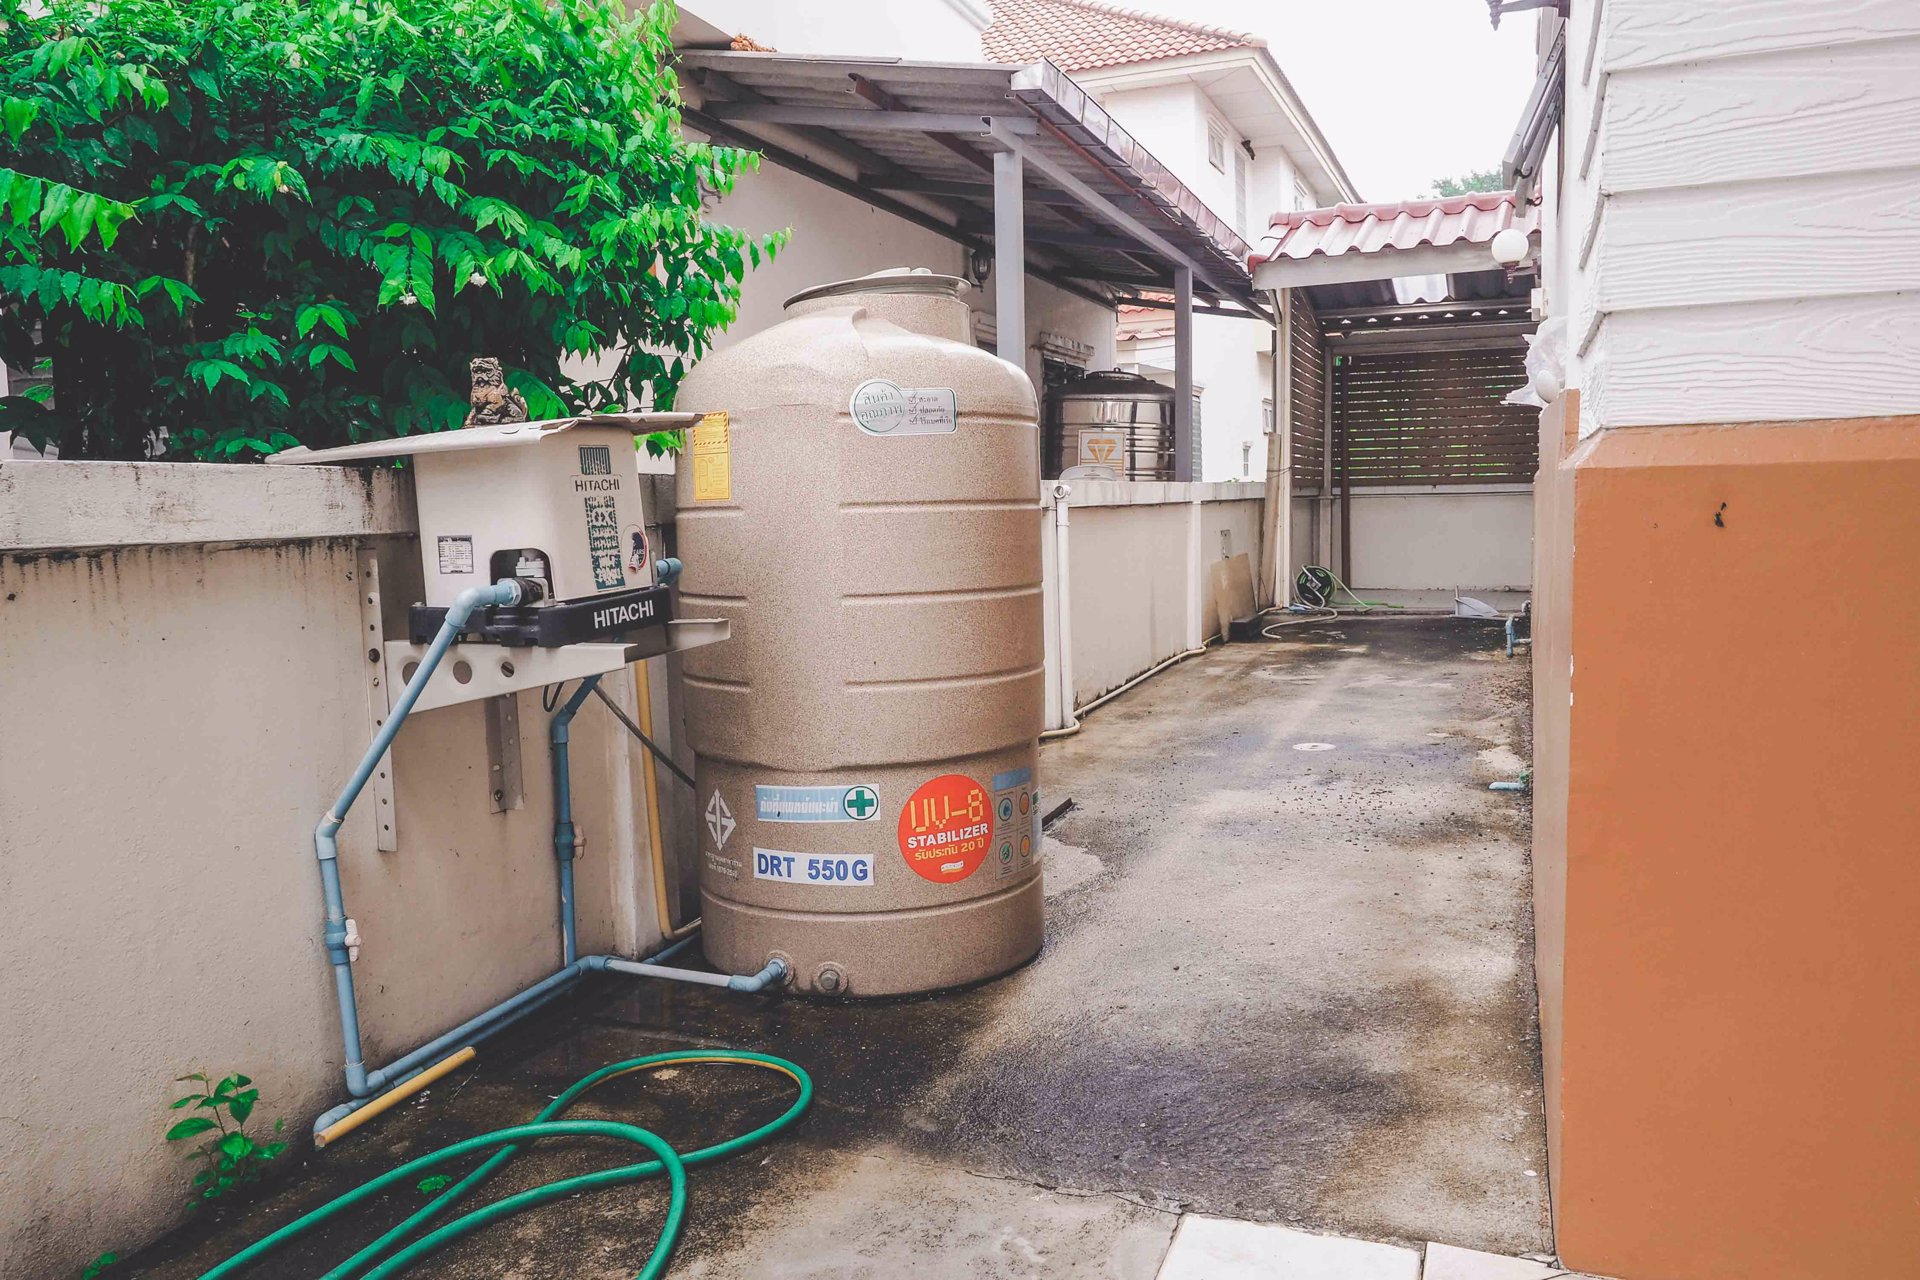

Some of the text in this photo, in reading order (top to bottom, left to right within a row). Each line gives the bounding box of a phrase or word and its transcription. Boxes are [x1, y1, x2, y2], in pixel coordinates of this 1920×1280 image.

[863, 388, 895, 405] สินค้า
[861, 405, 903, 424] คุณภาพ
[575, 478, 620, 492] HITACHI
[593, 599, 654, 630] HITACHI
[910, 788, 984, 833] UV-8
[907, 823, 989, 849] STABILIZER
[914, 837, 984, 861] รับประกัน 20 ปี
[757, 853, 795, 878] DRT
